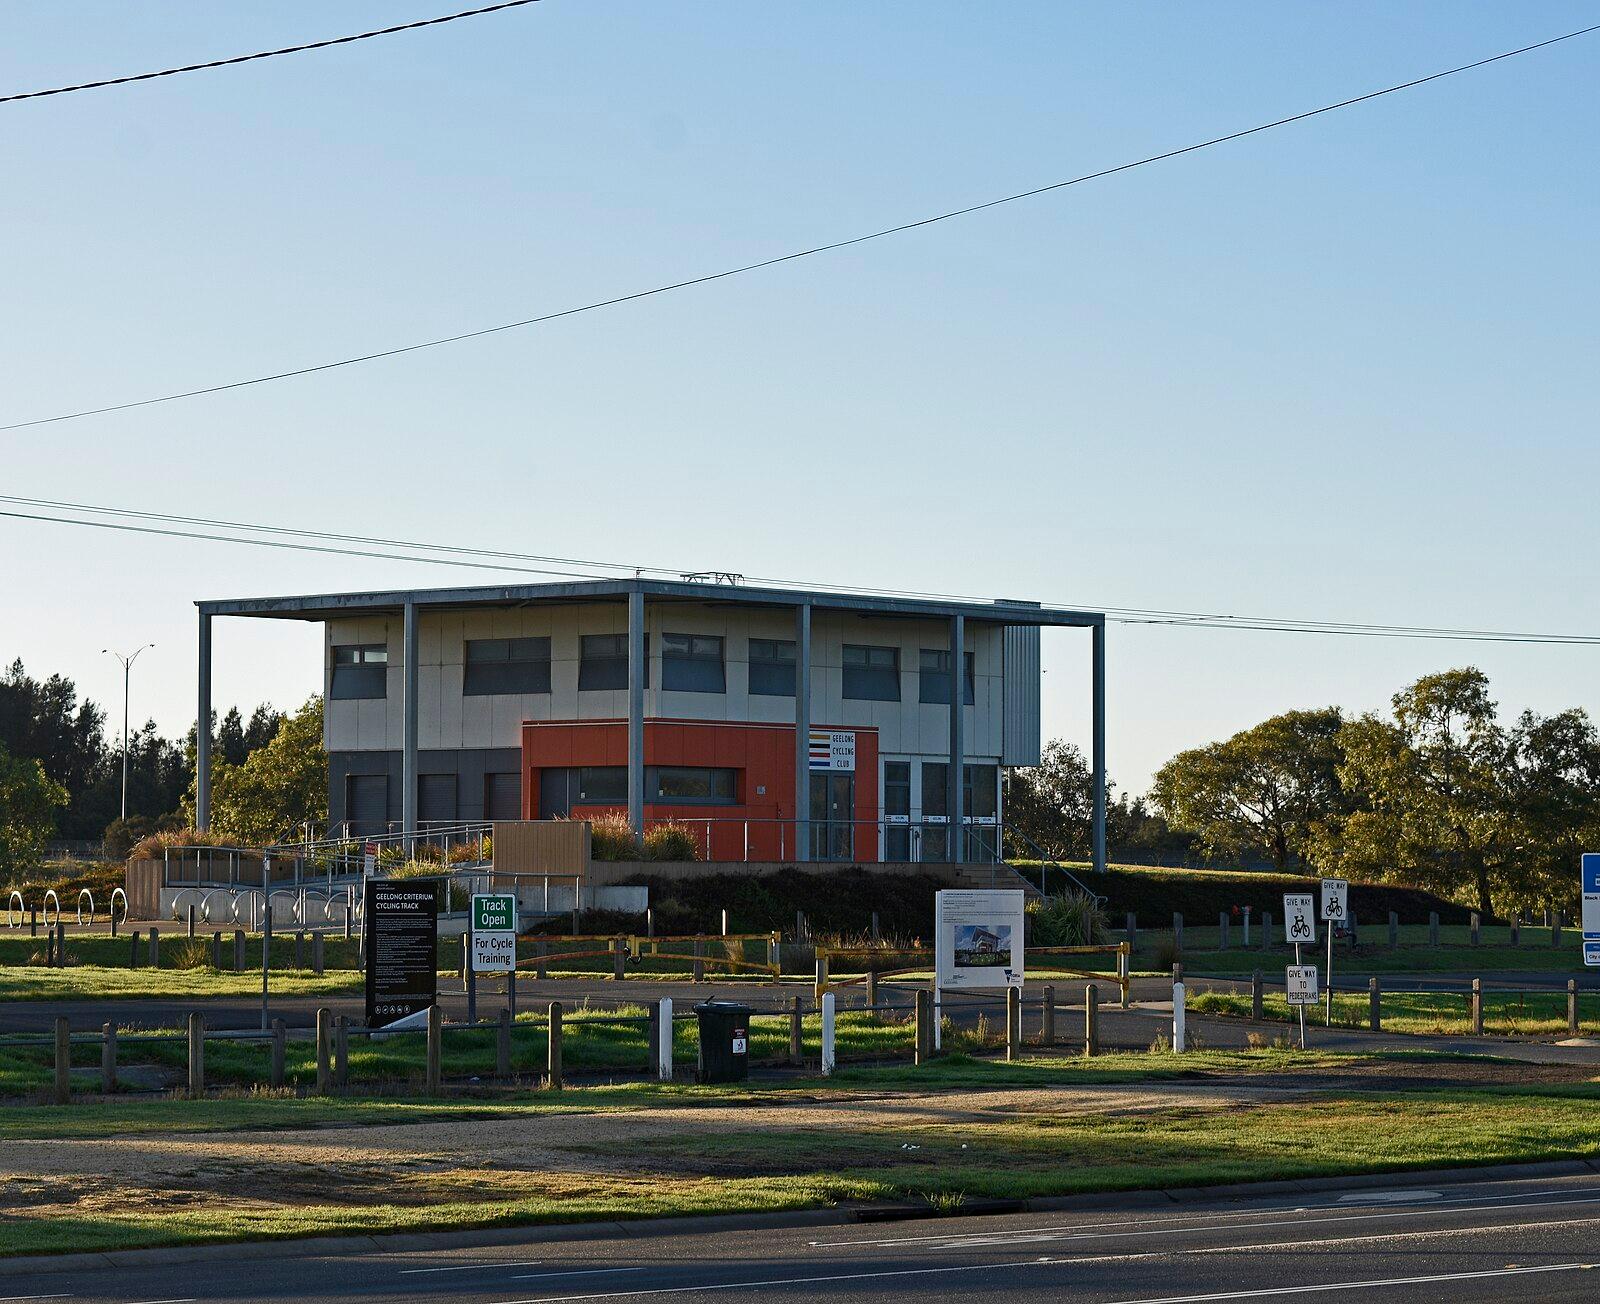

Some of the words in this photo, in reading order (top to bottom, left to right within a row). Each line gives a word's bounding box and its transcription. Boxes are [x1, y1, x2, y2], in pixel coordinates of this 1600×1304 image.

[832, 734, 854, 743] GEELONG
[832, 747, 854, 756] CYCLING
[836, 760, 850, 768] CLUB
[1323, 881, 1335, 890] GIVE
[375, 893, 403, 901] GEELONG
[403, 893, 434, 901] CRITERIUM
[375, 902, 401, 910] CYCLING
[401, 902, 419, 910] TRACK
[481, 898, 507, 911] Track
[1286, 898, 1298, 906] GIVE
[1300, 898, 1311, 906] WAY
[481, 913, 506, 928] Open
[475, 938, 489, 949] For
[490, 937, 513, 951] Cycle
[478, 952, 511, 966] Training
[1288, 970, 1301, 978] GIVE
[1304, 970, 1316, 978] WAY
[1299, 980, 1307, 989] TO
[1288, 991, 1317, 1000] PEDESTRIANS
